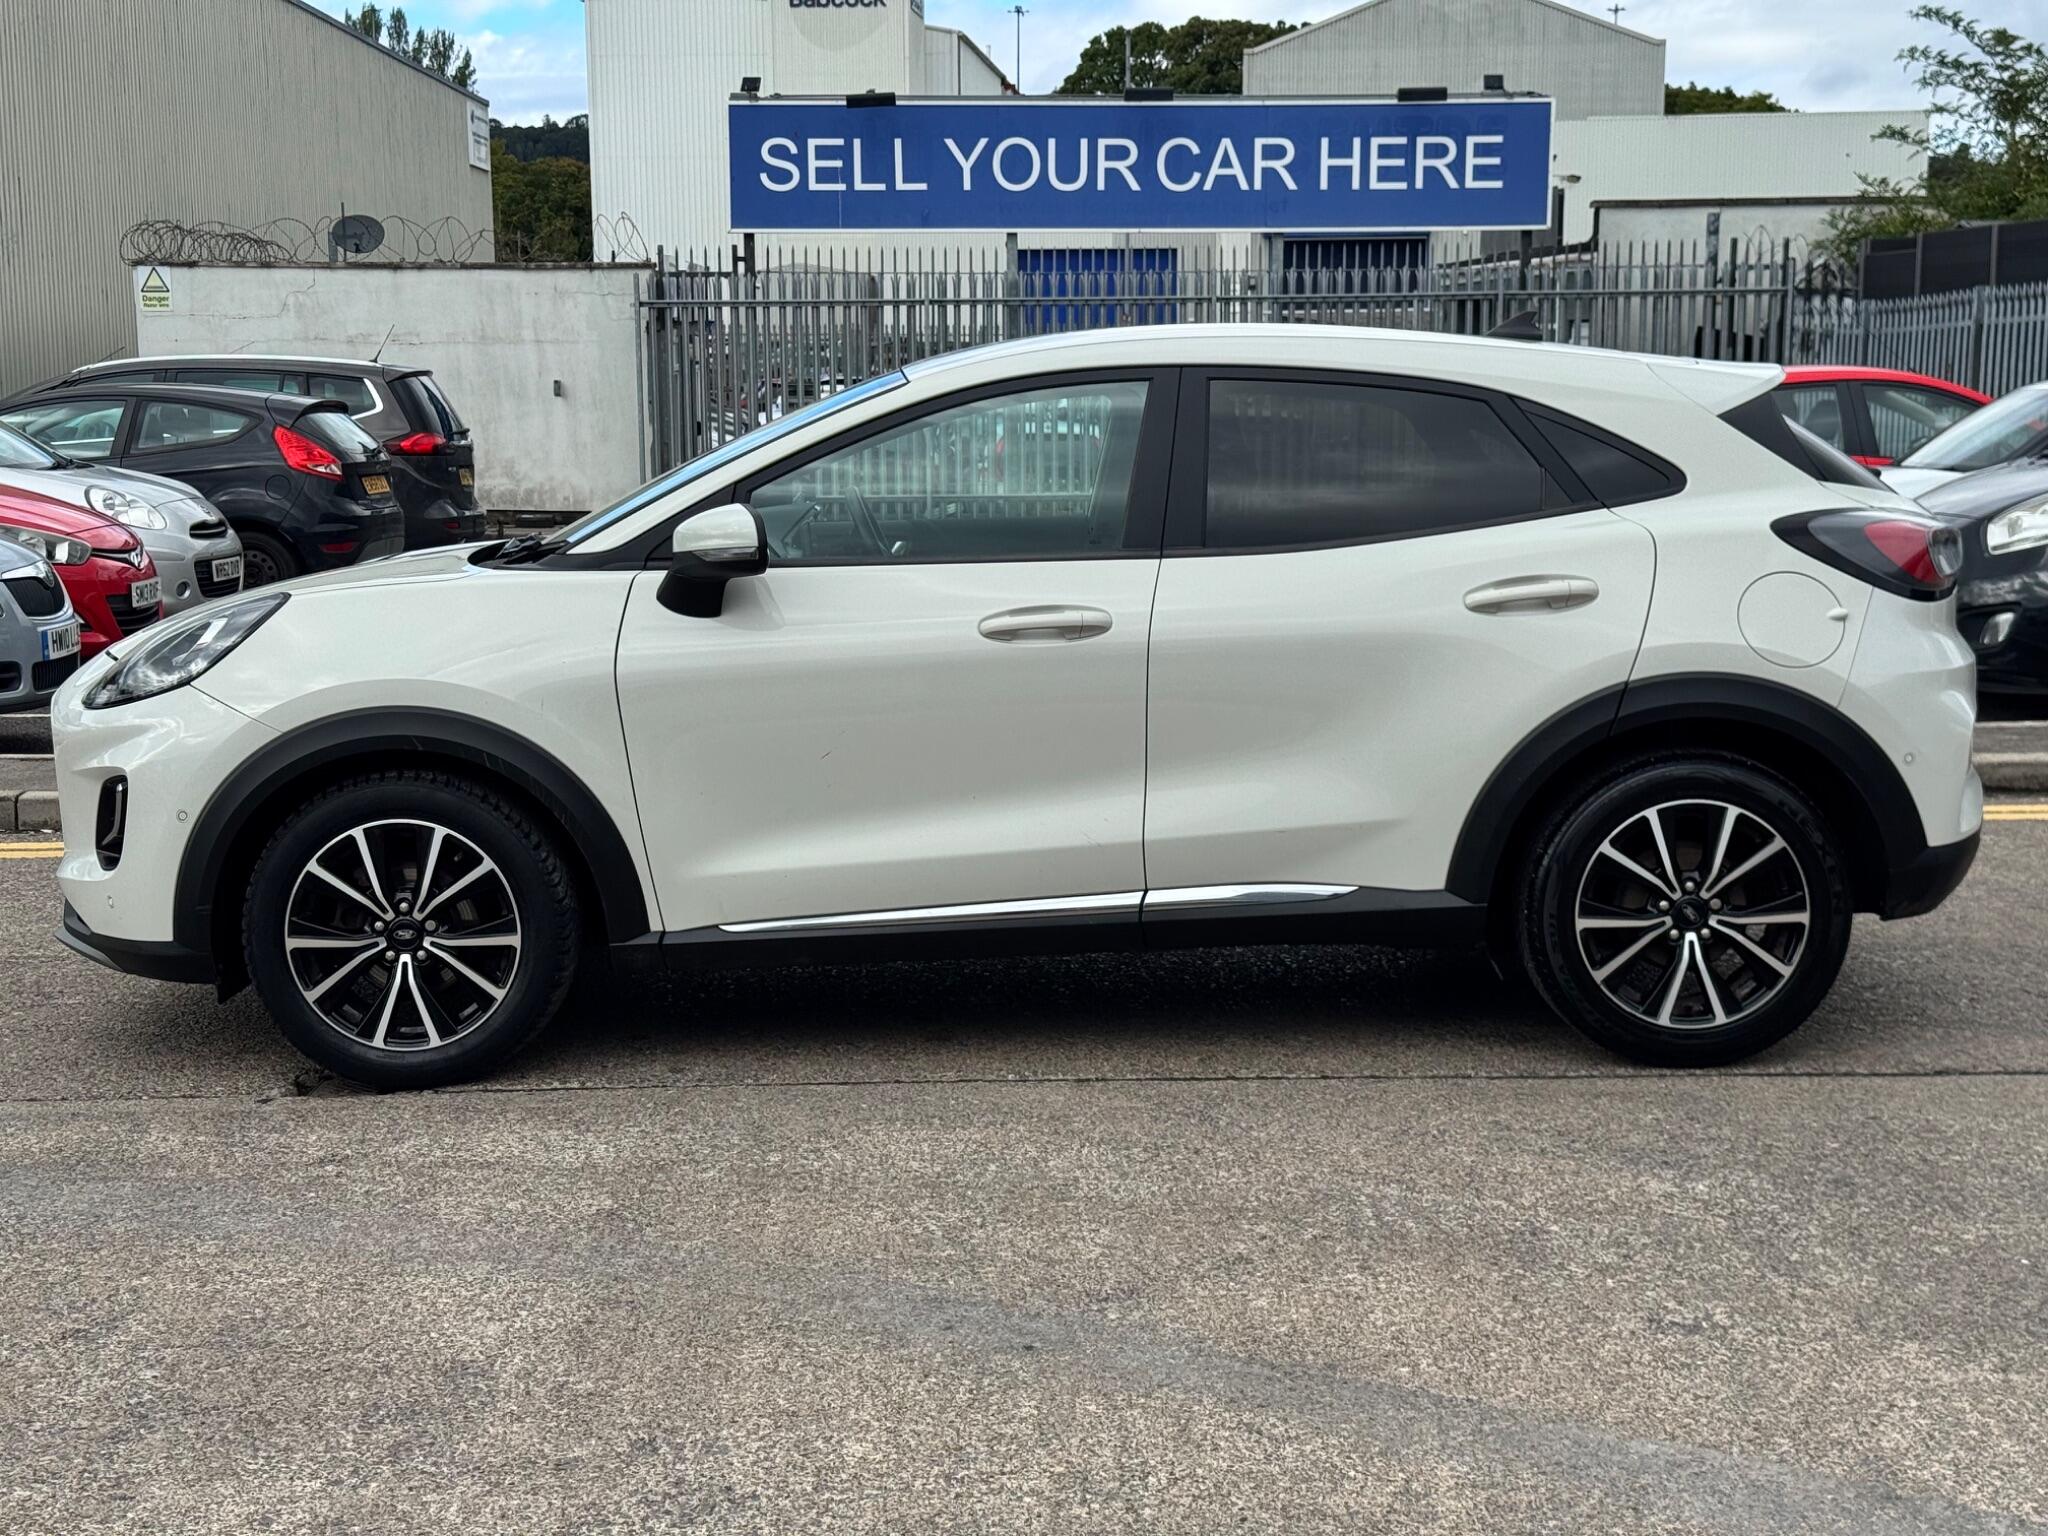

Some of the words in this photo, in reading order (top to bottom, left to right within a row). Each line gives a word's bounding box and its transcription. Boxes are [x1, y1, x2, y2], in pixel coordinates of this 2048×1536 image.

[759, 136, 928, 192] SELL
[943, 136, 1142, 192] YOUR
[1156, 136, 1299, 192] CAR
[1319, 134, 1504, 190] HERE
[142, 294, 170, 303] Danger
